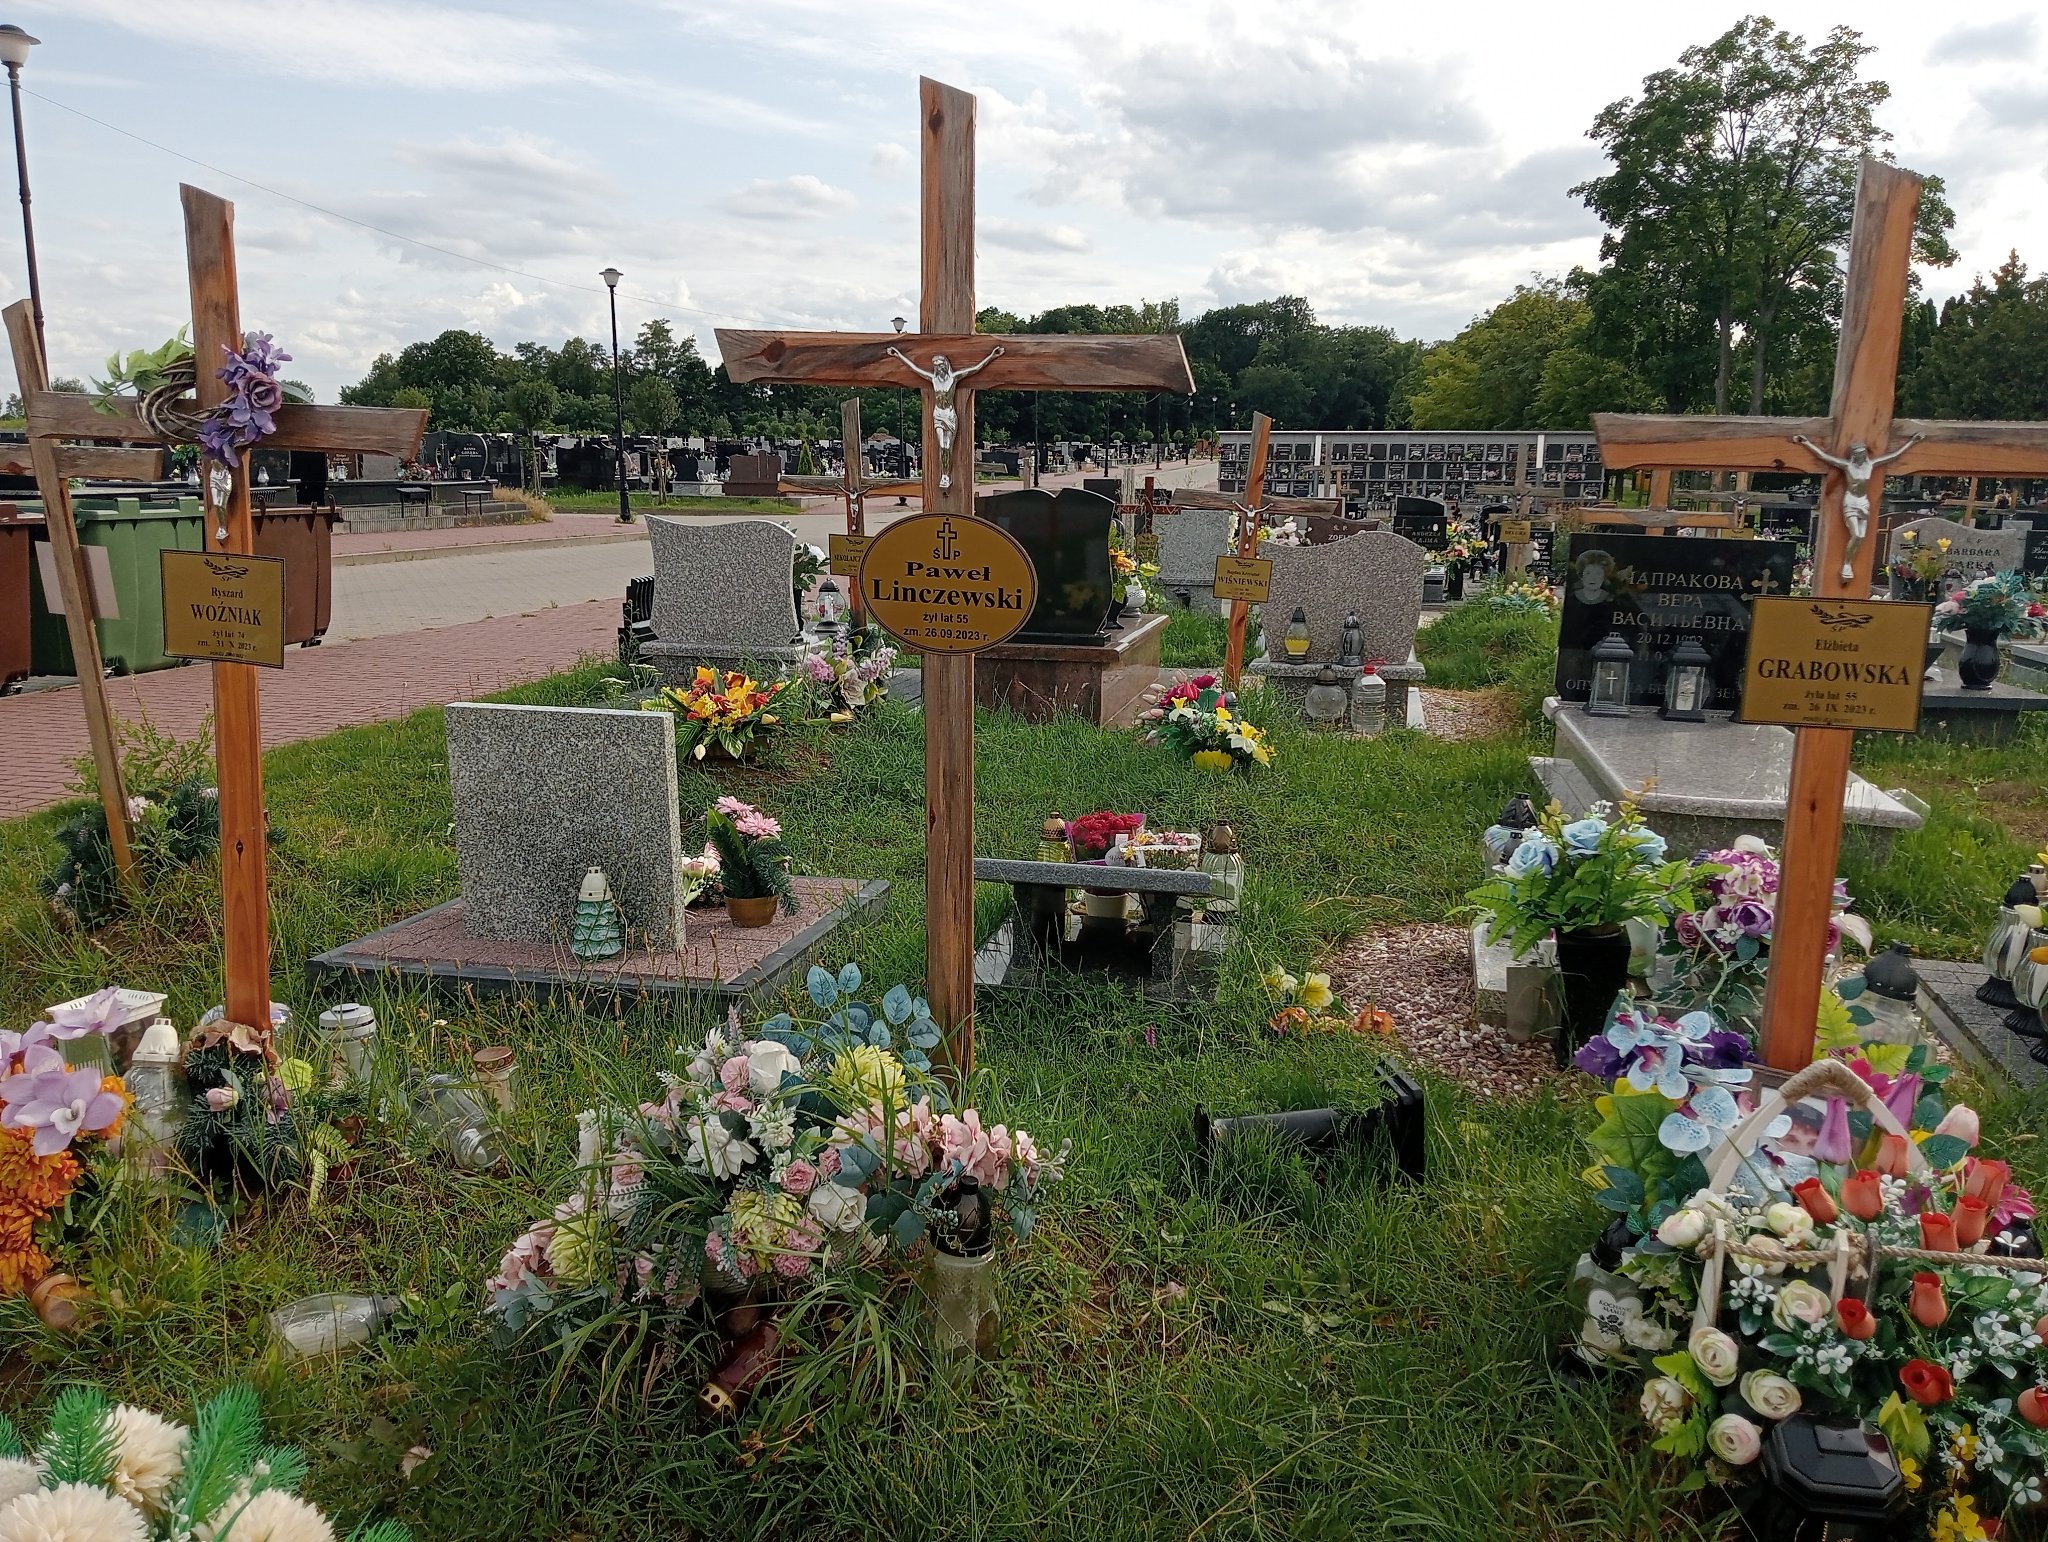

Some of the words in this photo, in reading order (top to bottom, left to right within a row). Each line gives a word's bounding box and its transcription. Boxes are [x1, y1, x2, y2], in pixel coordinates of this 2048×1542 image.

[933, 547, 940, 559] Ś
[953, 550, 960, 560] P
[905, 561, 992, 581] Paweł
[1218, 575, 1267, 587] WIŚNIEWSKI
[212, 587, 243, 599] Ryszard
[872, 578, 1023, 610] Linczewski
[1658, 593, 1703, 609] ВЕРА
[190, 601, 261, 626] WOŹNIAK
[941, 612, 953, 623] lat
[956, 614, 968, 624] 55
[1612, 611, 1745, 631] ВАСИЛЬЕВНА
[904, 628, 921, 636] zm.
[925, 628, 980, 640] 26.09.2023
[238, 641, 251, 651] 2023
[1815, 638, 1859, 652] Elżbieta
[1758, 658, 1910, 685] GRABOWSKA
[1827, 691, 1840, 700] lat
[1845, 692, 1857, 700] 55
[1809, 703, 1820, 712] 26
[1826, 703, 1838, 712] IX
[1844, 704, 1866, 714] 2023
